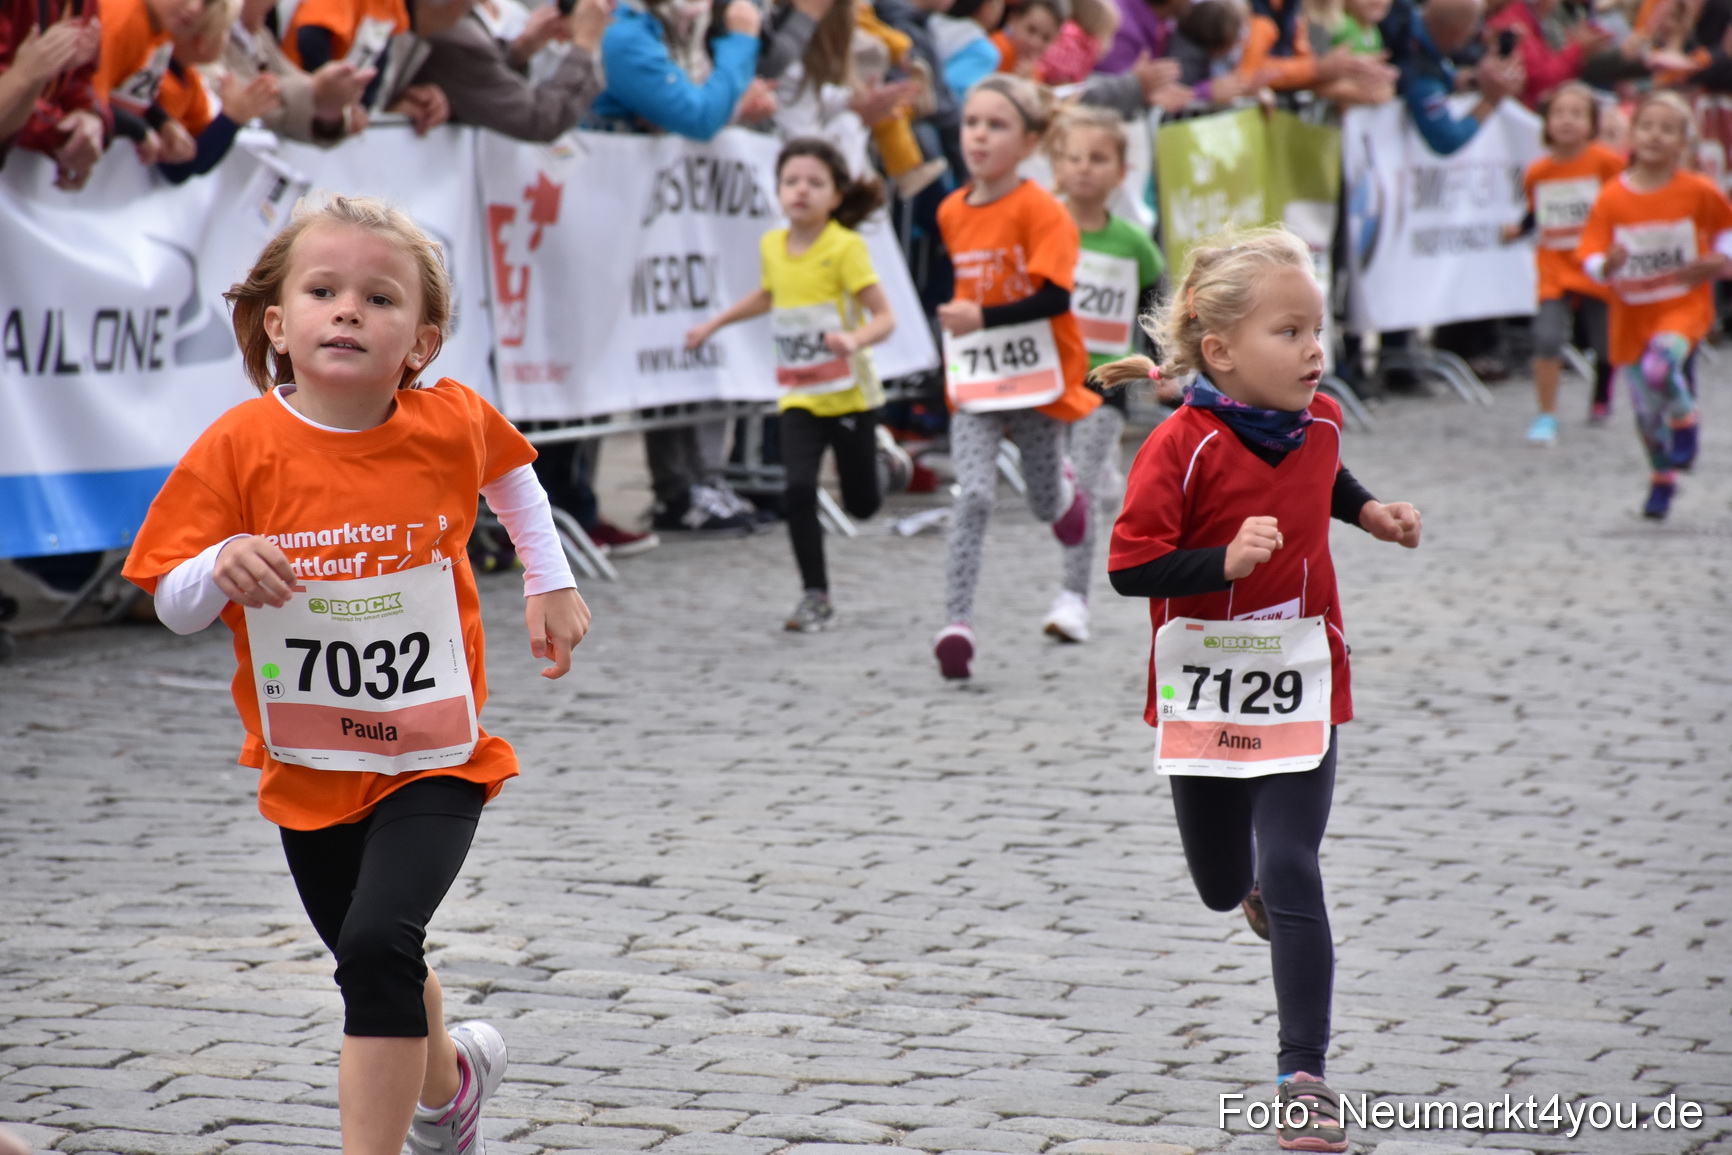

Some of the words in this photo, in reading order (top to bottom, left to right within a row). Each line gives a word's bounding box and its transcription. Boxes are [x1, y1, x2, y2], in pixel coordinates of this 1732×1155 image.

[1075, 281, 1126, 316] 201
[963, 337, 1039, 375] 7148
[261, 522, 397, 549] eumarkter
[290, 552, 368, 578] dtlauf
[330, 592, 403, 615] BOCK
[1222, 635, 1282, 650] BOCK
[285, 631, 436, 700] 7032
[266, 684, 280, 695] B1
[1182, 664, 1303, 714] 7129
[1163, 704, 1173, 714] B1
[341, 717, 398, 742] Paula
[1217, 730, 1262, 750] Anna
